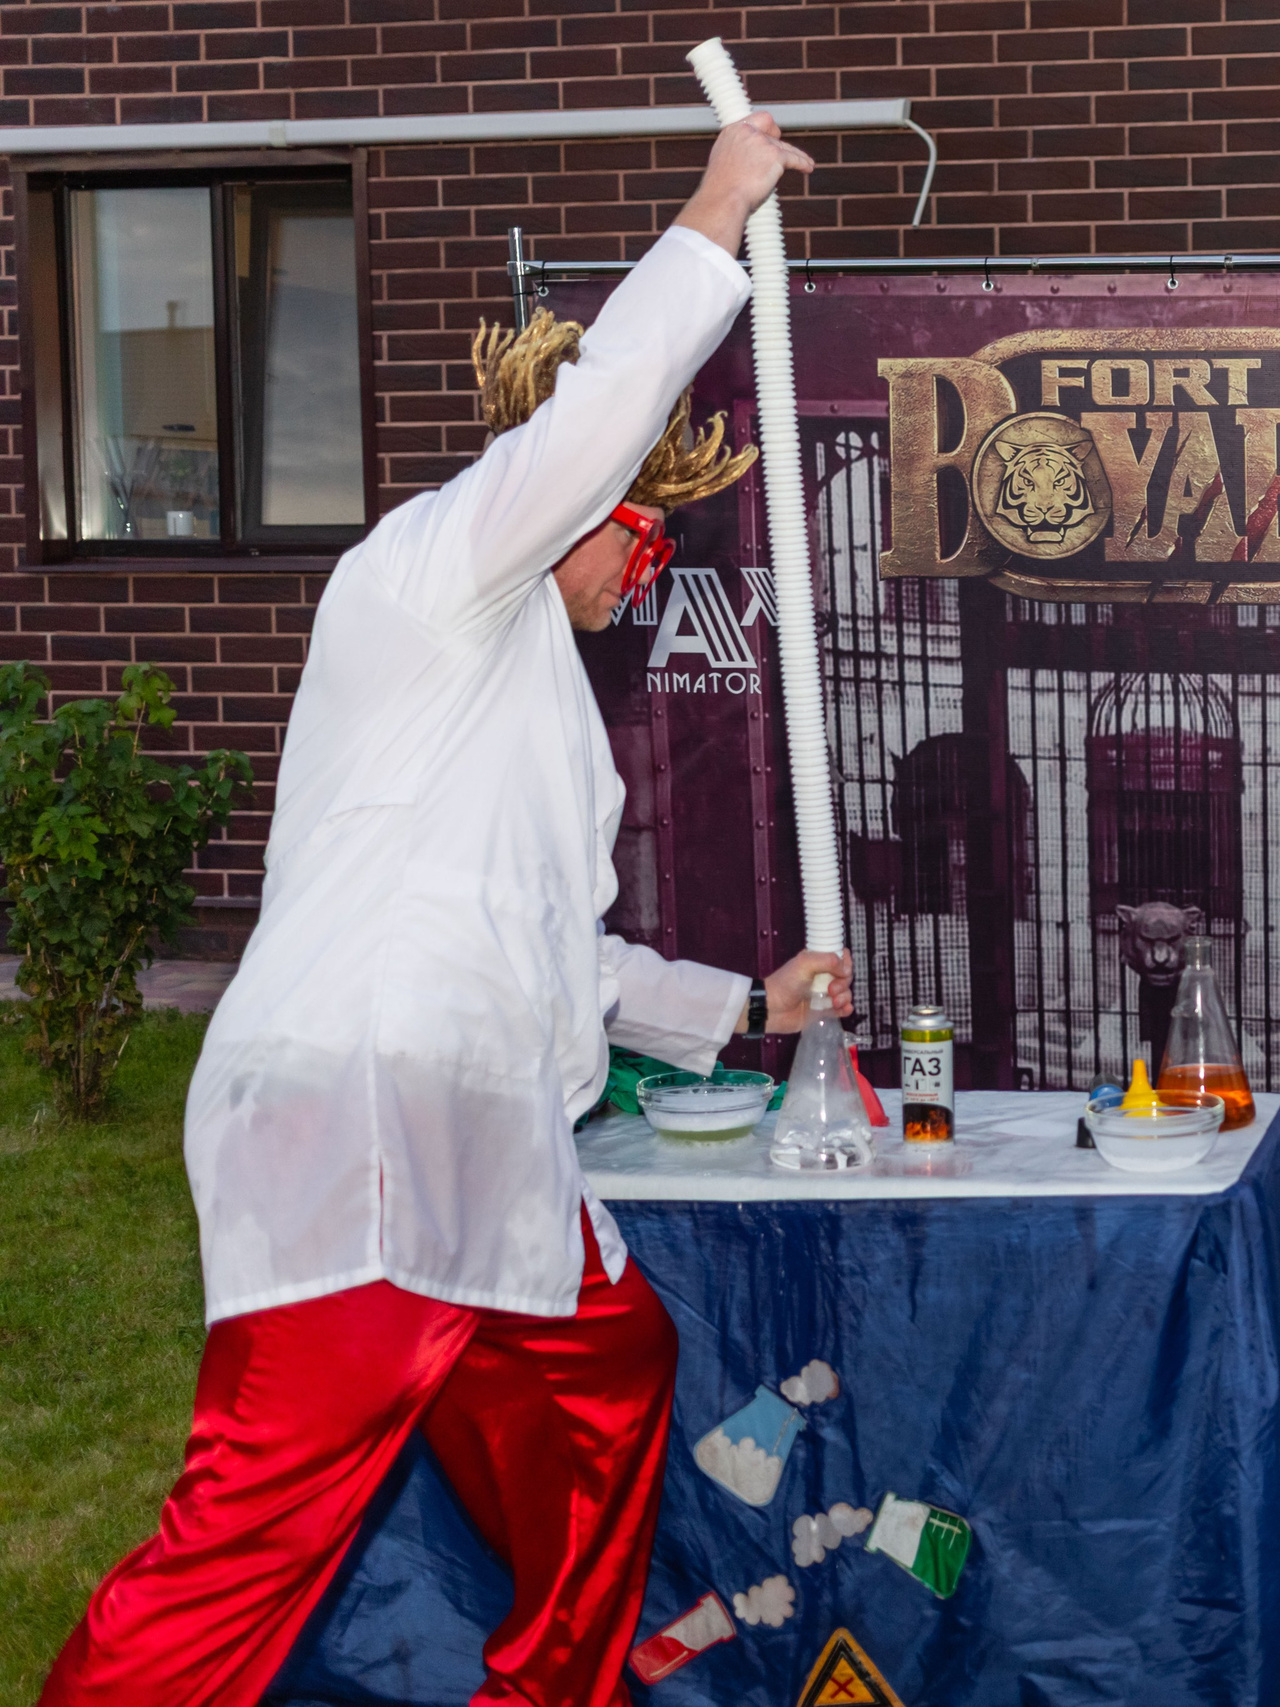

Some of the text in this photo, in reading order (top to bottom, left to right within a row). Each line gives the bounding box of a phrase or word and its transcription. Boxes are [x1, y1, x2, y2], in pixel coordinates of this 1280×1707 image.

[1040, 357, 1261, 406] FORT
[646, 671, 762, 695] NIMATOR
[903, 1056, 942, 1077] ГАЗ
